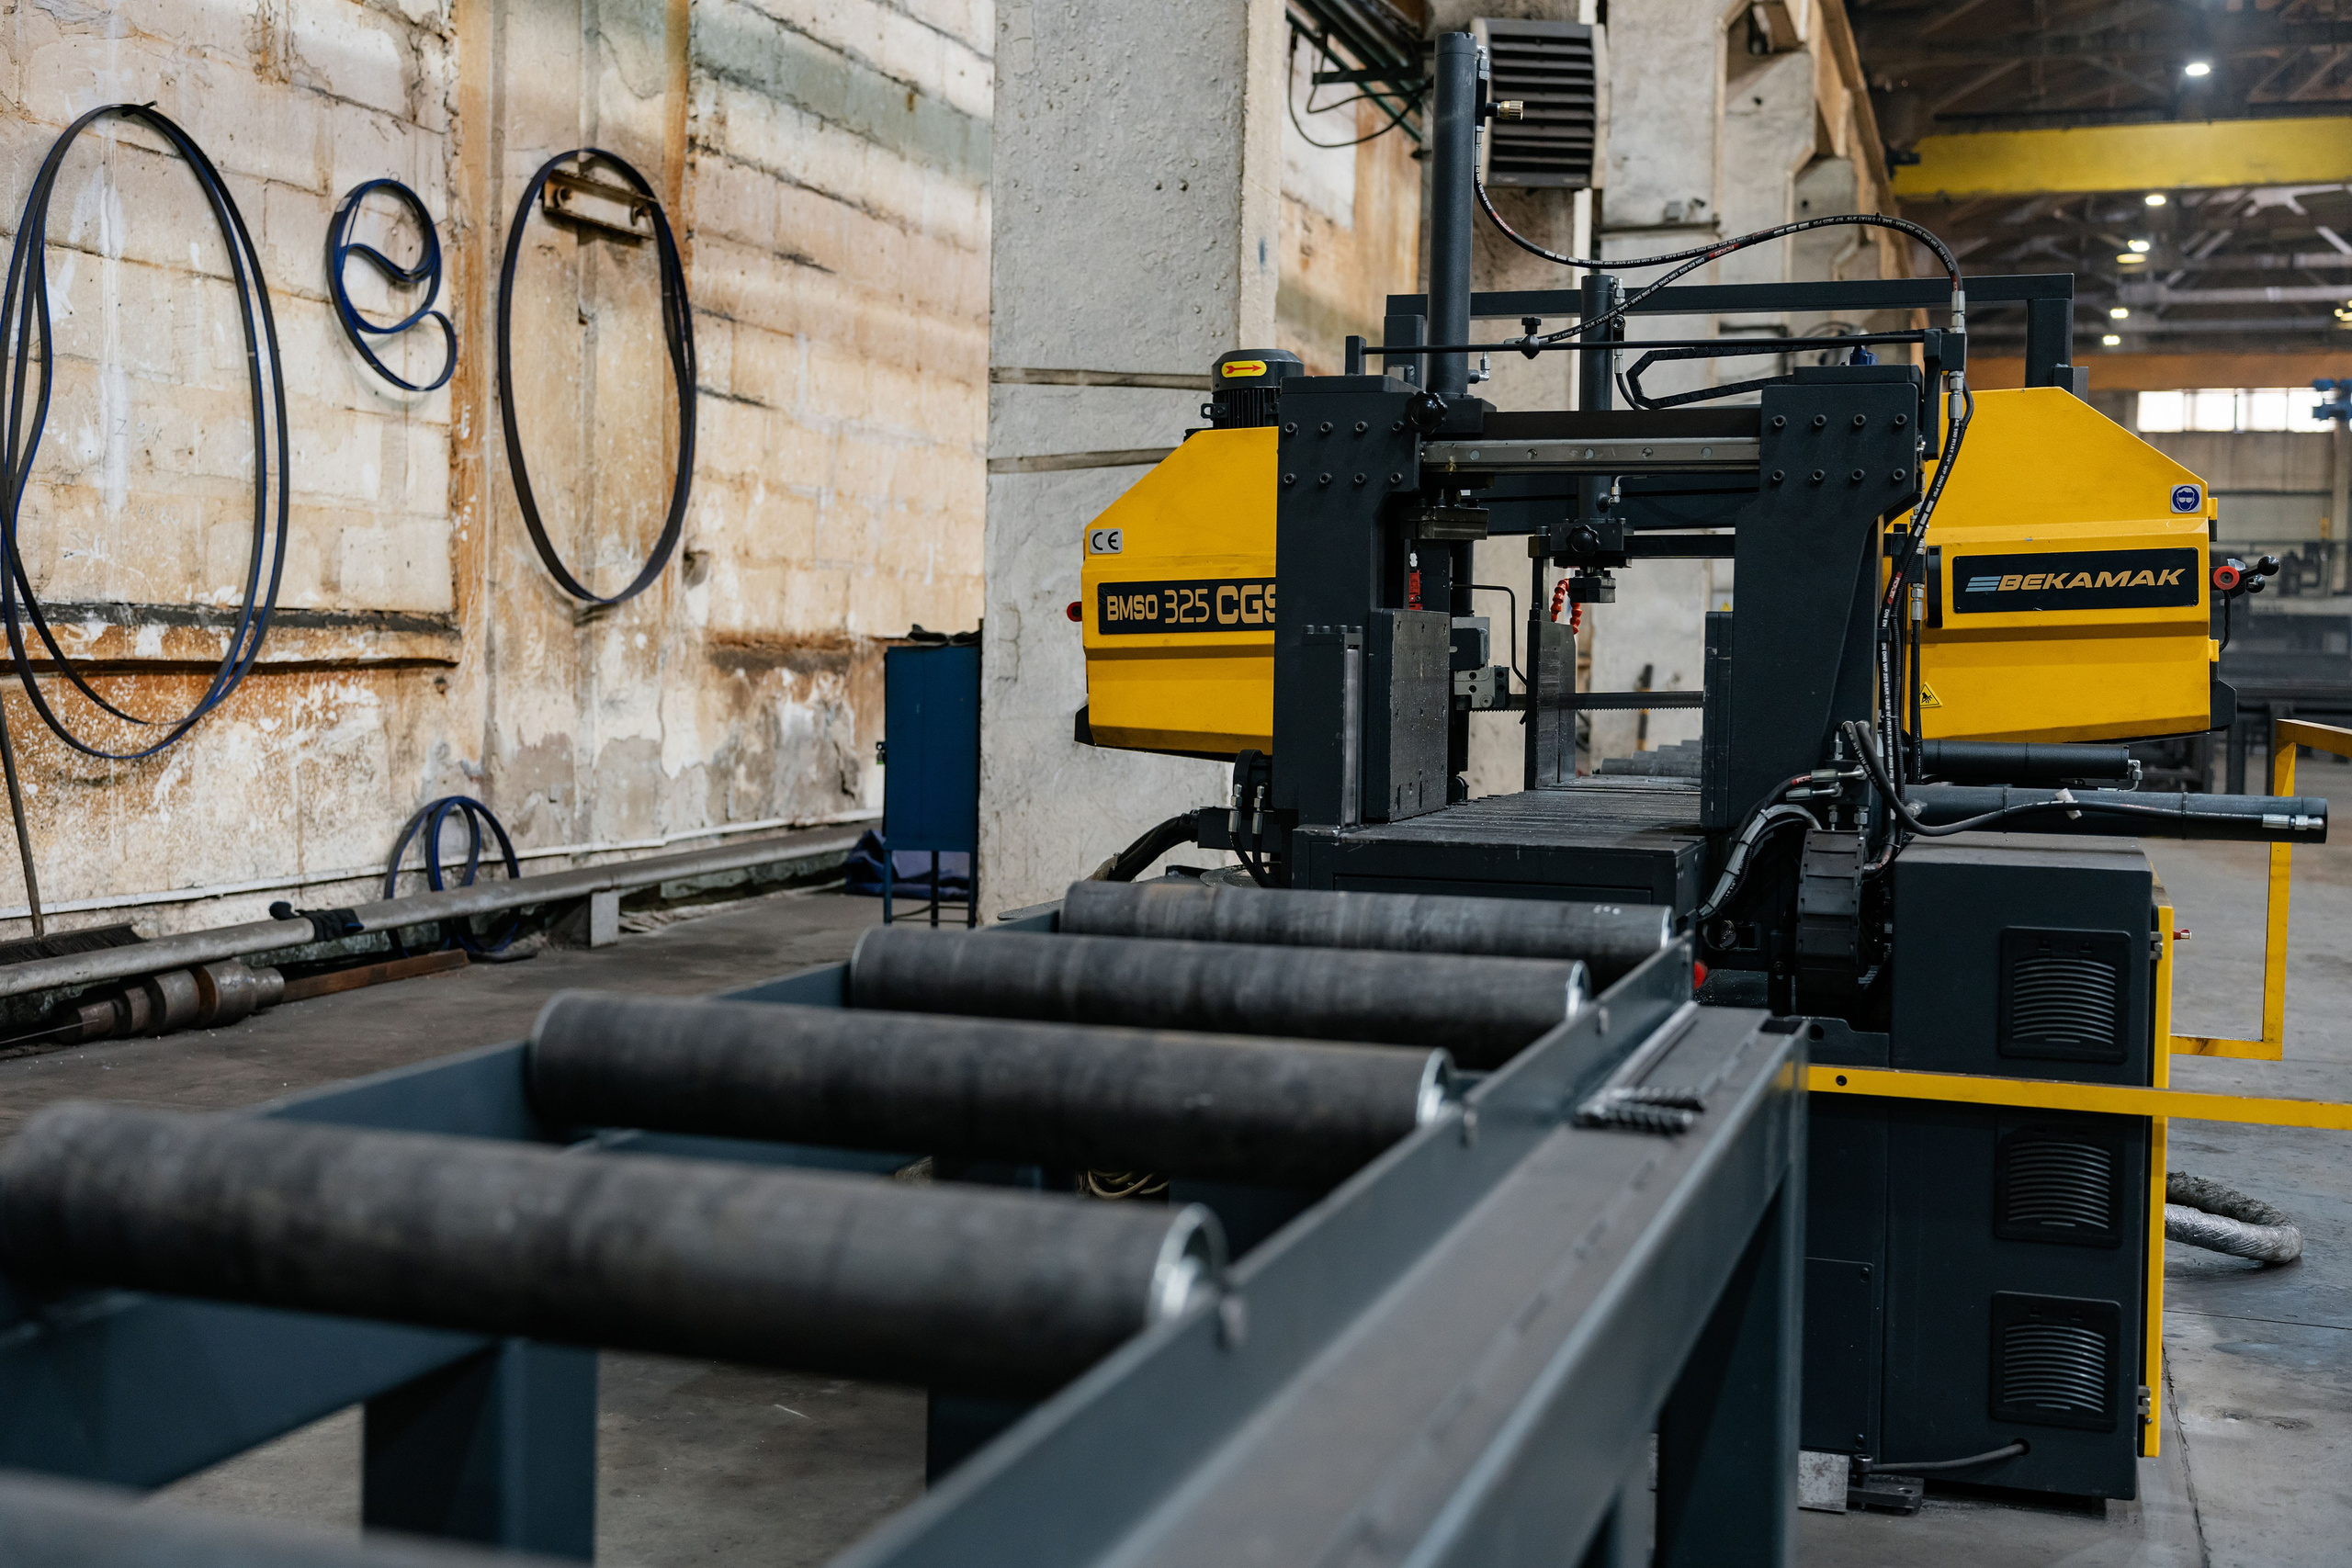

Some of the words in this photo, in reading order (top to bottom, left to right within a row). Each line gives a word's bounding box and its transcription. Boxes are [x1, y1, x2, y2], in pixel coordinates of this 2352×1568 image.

[1650, 284, 1659, 292] WP
[1641, 289, 1651, 298] 250
[1630, 295, 1642, 304] BAR
[1617, 303, 1629, 312] SAE
[1595, 315, 1609, 324] R1AT
[1091, 531, 1119, 551] CE
[1996, 568, 2186, 592] BEKAMAK
[1164, 588, 1210, 624] 325
[1883, 662, 1888, 671] WP
[1887, 747, 1893, 756] WP
